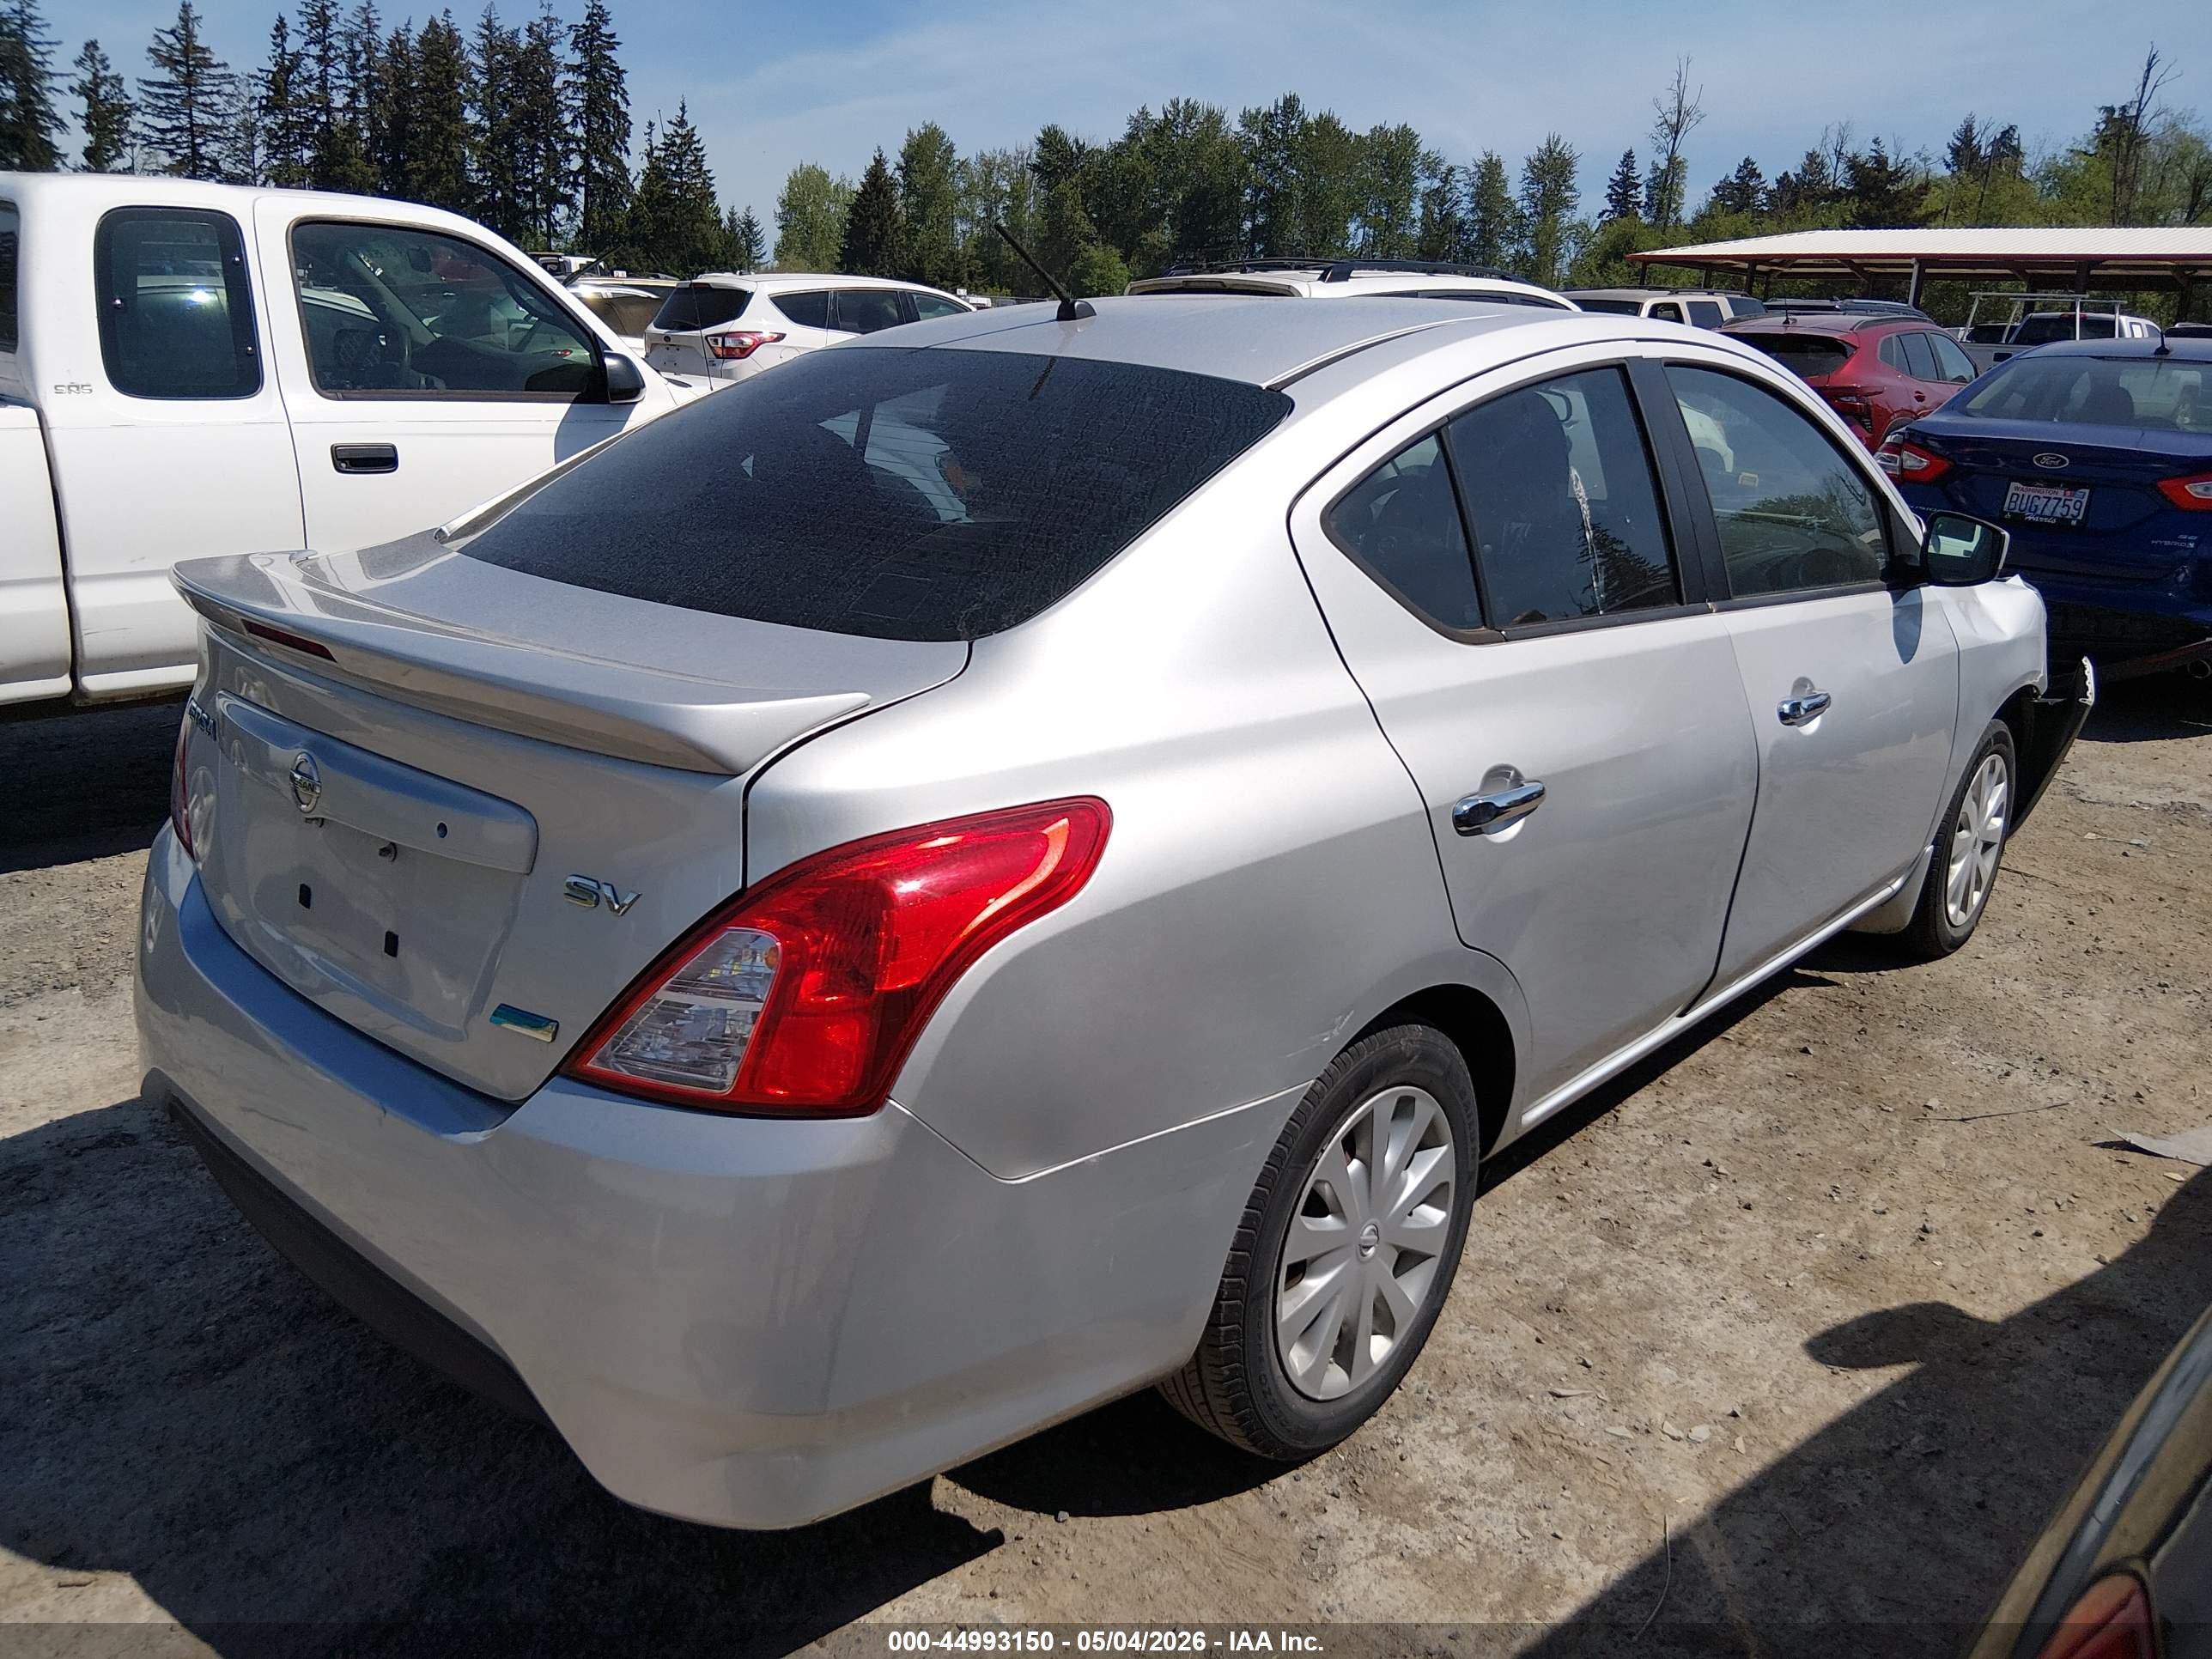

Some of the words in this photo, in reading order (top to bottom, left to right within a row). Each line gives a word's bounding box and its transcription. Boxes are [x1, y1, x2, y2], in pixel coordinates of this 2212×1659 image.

[54, 385, 93, 394] SR5
[2039, 456, 2062, 465] Ford
[2014, 486, 2059, 495] WASHINGTON
[2008, 492, 2083, 519] BUG7759
[563, 874, 642, 916] SV
